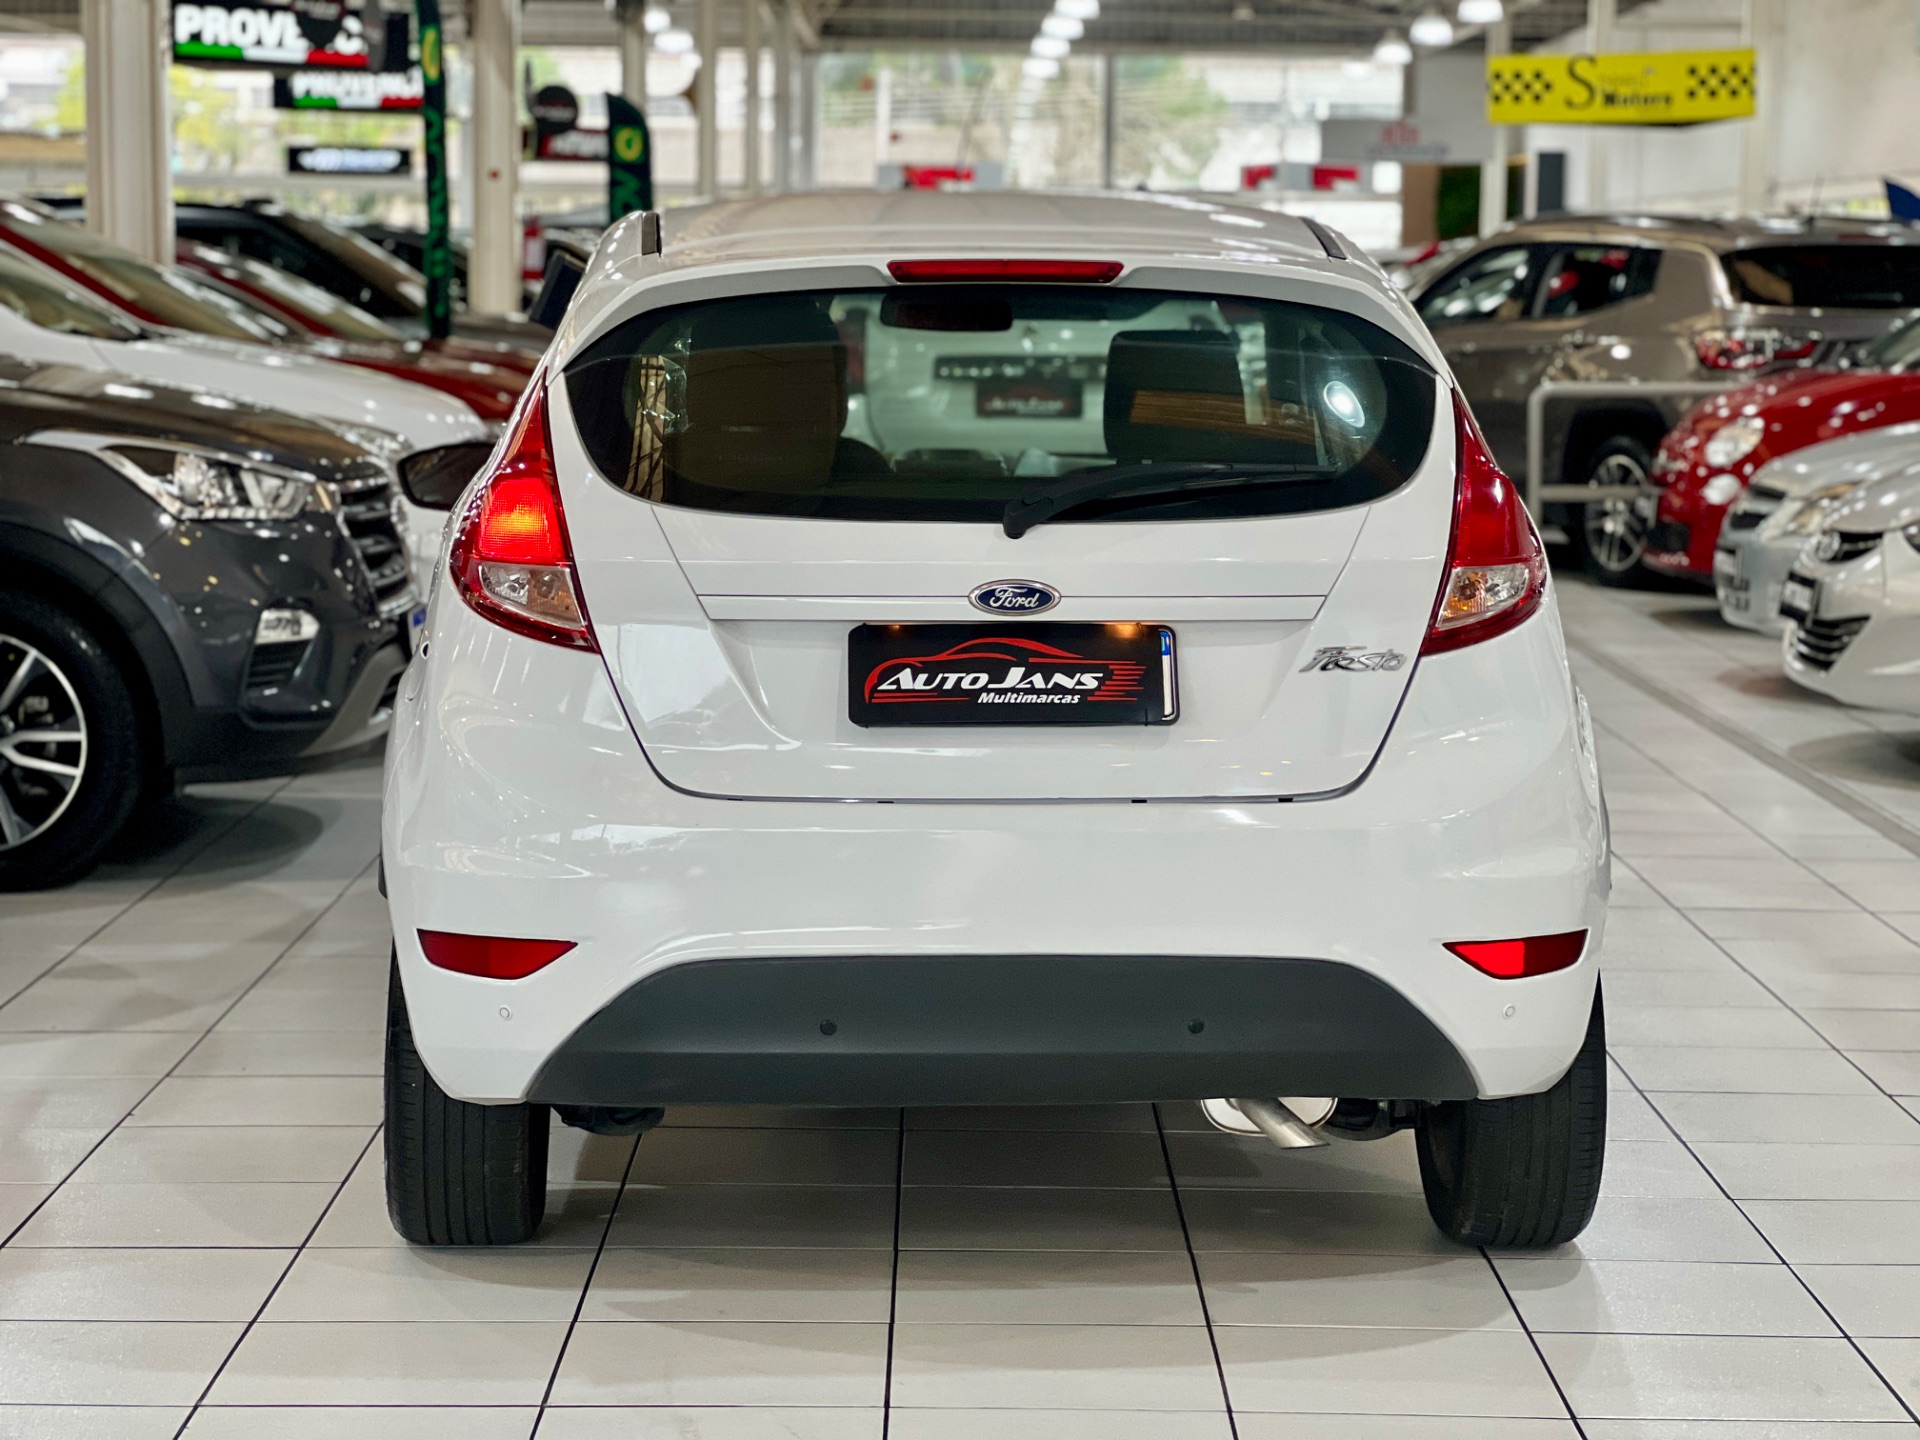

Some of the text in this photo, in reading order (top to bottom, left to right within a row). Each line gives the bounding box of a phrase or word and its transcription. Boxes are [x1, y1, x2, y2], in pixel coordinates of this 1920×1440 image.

[989, 586, 1040, 608] Ford
[1298, 645, 1408, 673] Fiesta
[877, 666, 1104, 690] AUTO JANS
[976, 692, 1081, 704] Multimarcas
